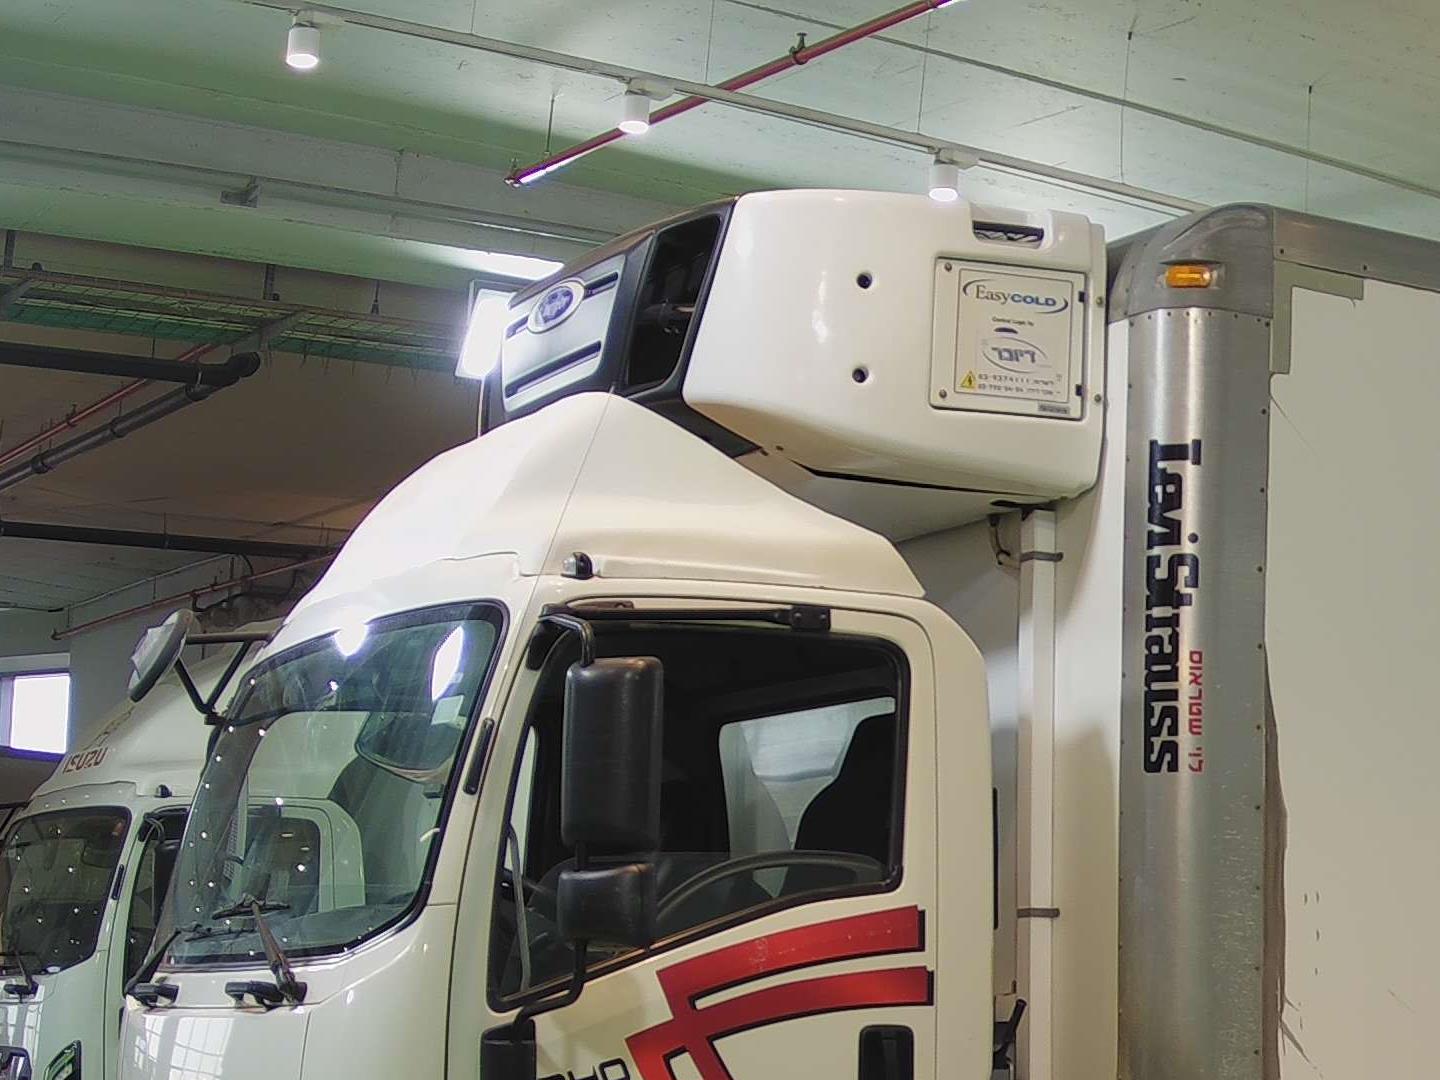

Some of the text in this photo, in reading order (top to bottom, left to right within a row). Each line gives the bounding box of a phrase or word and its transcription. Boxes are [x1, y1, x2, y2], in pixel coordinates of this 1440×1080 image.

[1143, 552, 1200, 774] Strauss
[1188, 649, 1204, 773] לוי שטראוס
[63, 746, 109, 774] ISUZU
